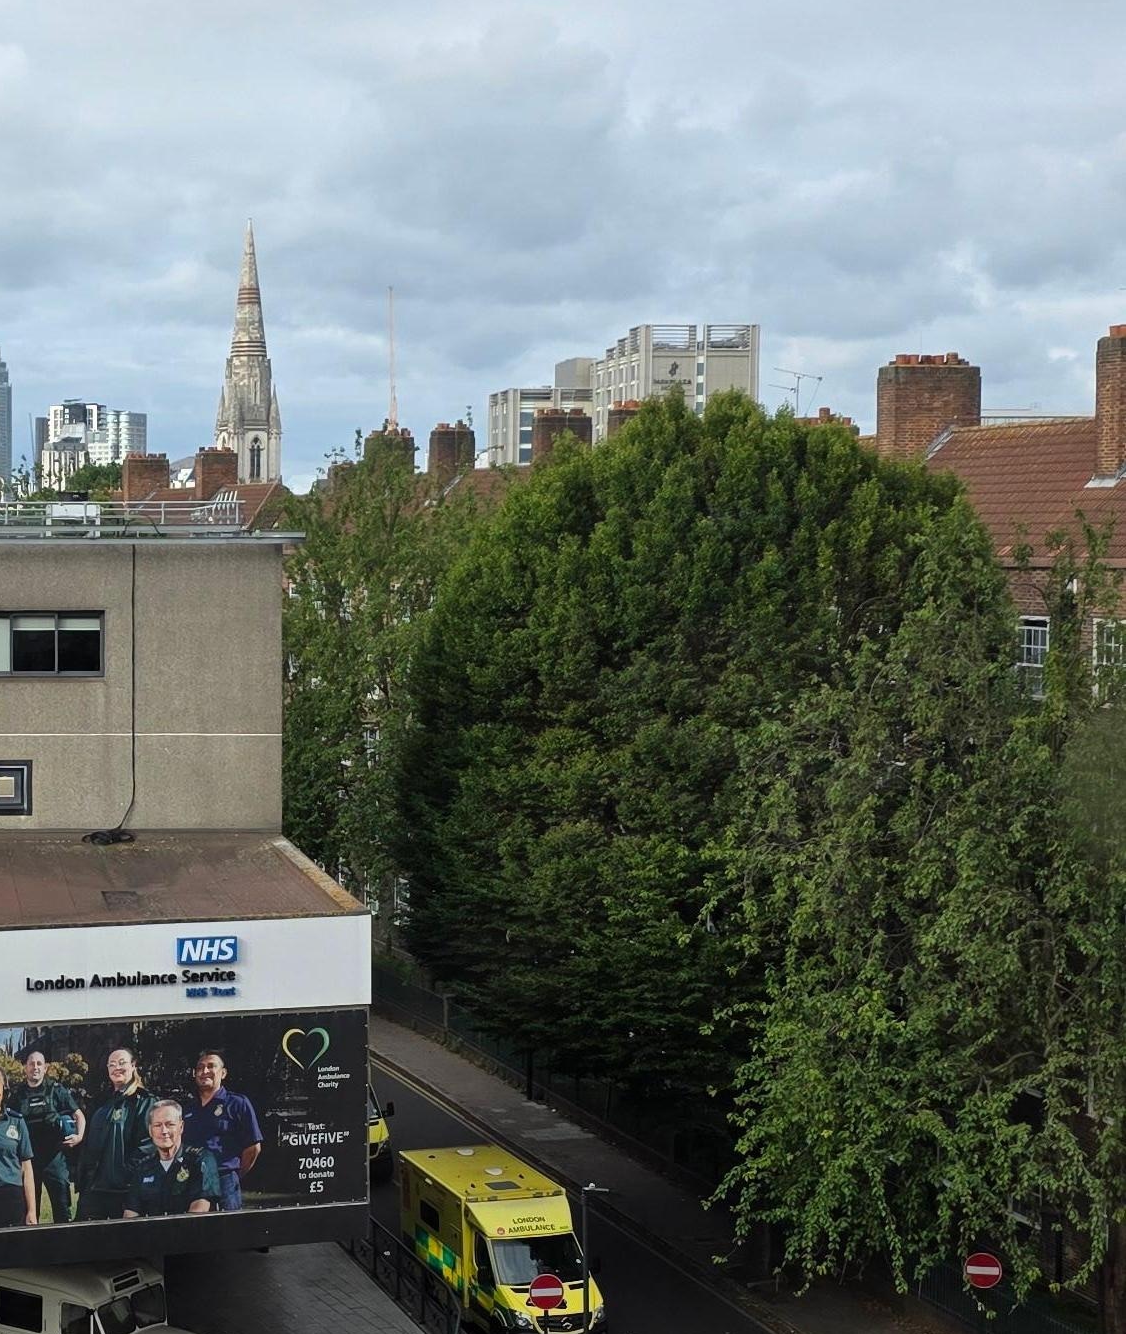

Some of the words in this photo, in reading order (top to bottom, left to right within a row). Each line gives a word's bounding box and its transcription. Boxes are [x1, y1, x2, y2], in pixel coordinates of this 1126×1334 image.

[180, 938, 236, 962] NHS
[26, 974, 85, 991] London
[89, 971, 177, 988] Ambulance
[181, 967, 236, 984] Service
[186, 987, 208, 998] NHS
[211, 986, 236, 997] Trust
[317, 1065, 339, 1073] London
[317, 1072, 350, 1081] Ambulance
[317, 1081, 339, 1089] Charity
[307, 1122, 325, 1131] Text:
[282, 1131, 350, 1147] "GIVEFIVE"
[312, 1147, 321, 1155] to
[298, 1155, 335, 1170] 70460
[298, 1171, 307, 1179] to
[308, 1170, 335, 1179] donate
[309, 1180, 324, 1193] £5
[512, 1216, 546, 1225] LONDON
[508, 1224, 556, 1234] AMBULANCE
